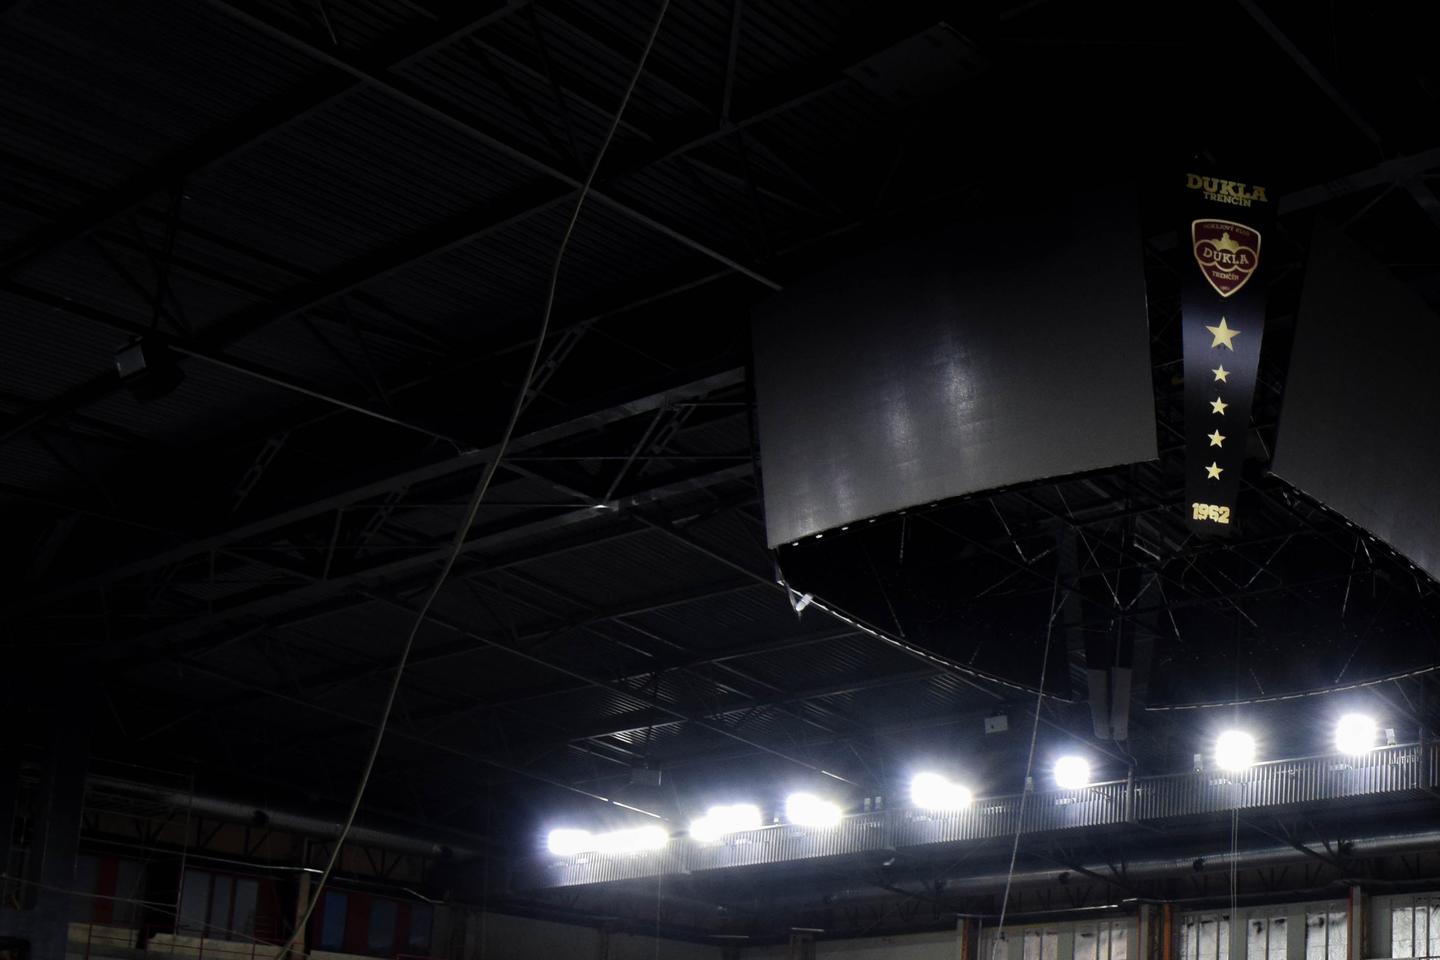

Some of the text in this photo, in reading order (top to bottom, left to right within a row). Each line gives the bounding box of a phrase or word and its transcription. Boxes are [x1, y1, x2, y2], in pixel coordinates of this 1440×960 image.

[1186, 173, 1268, 202] DUKLA
[1203, 247, 1249, 264] DUKLA
[1192, 502, 1230, 524] 1962
